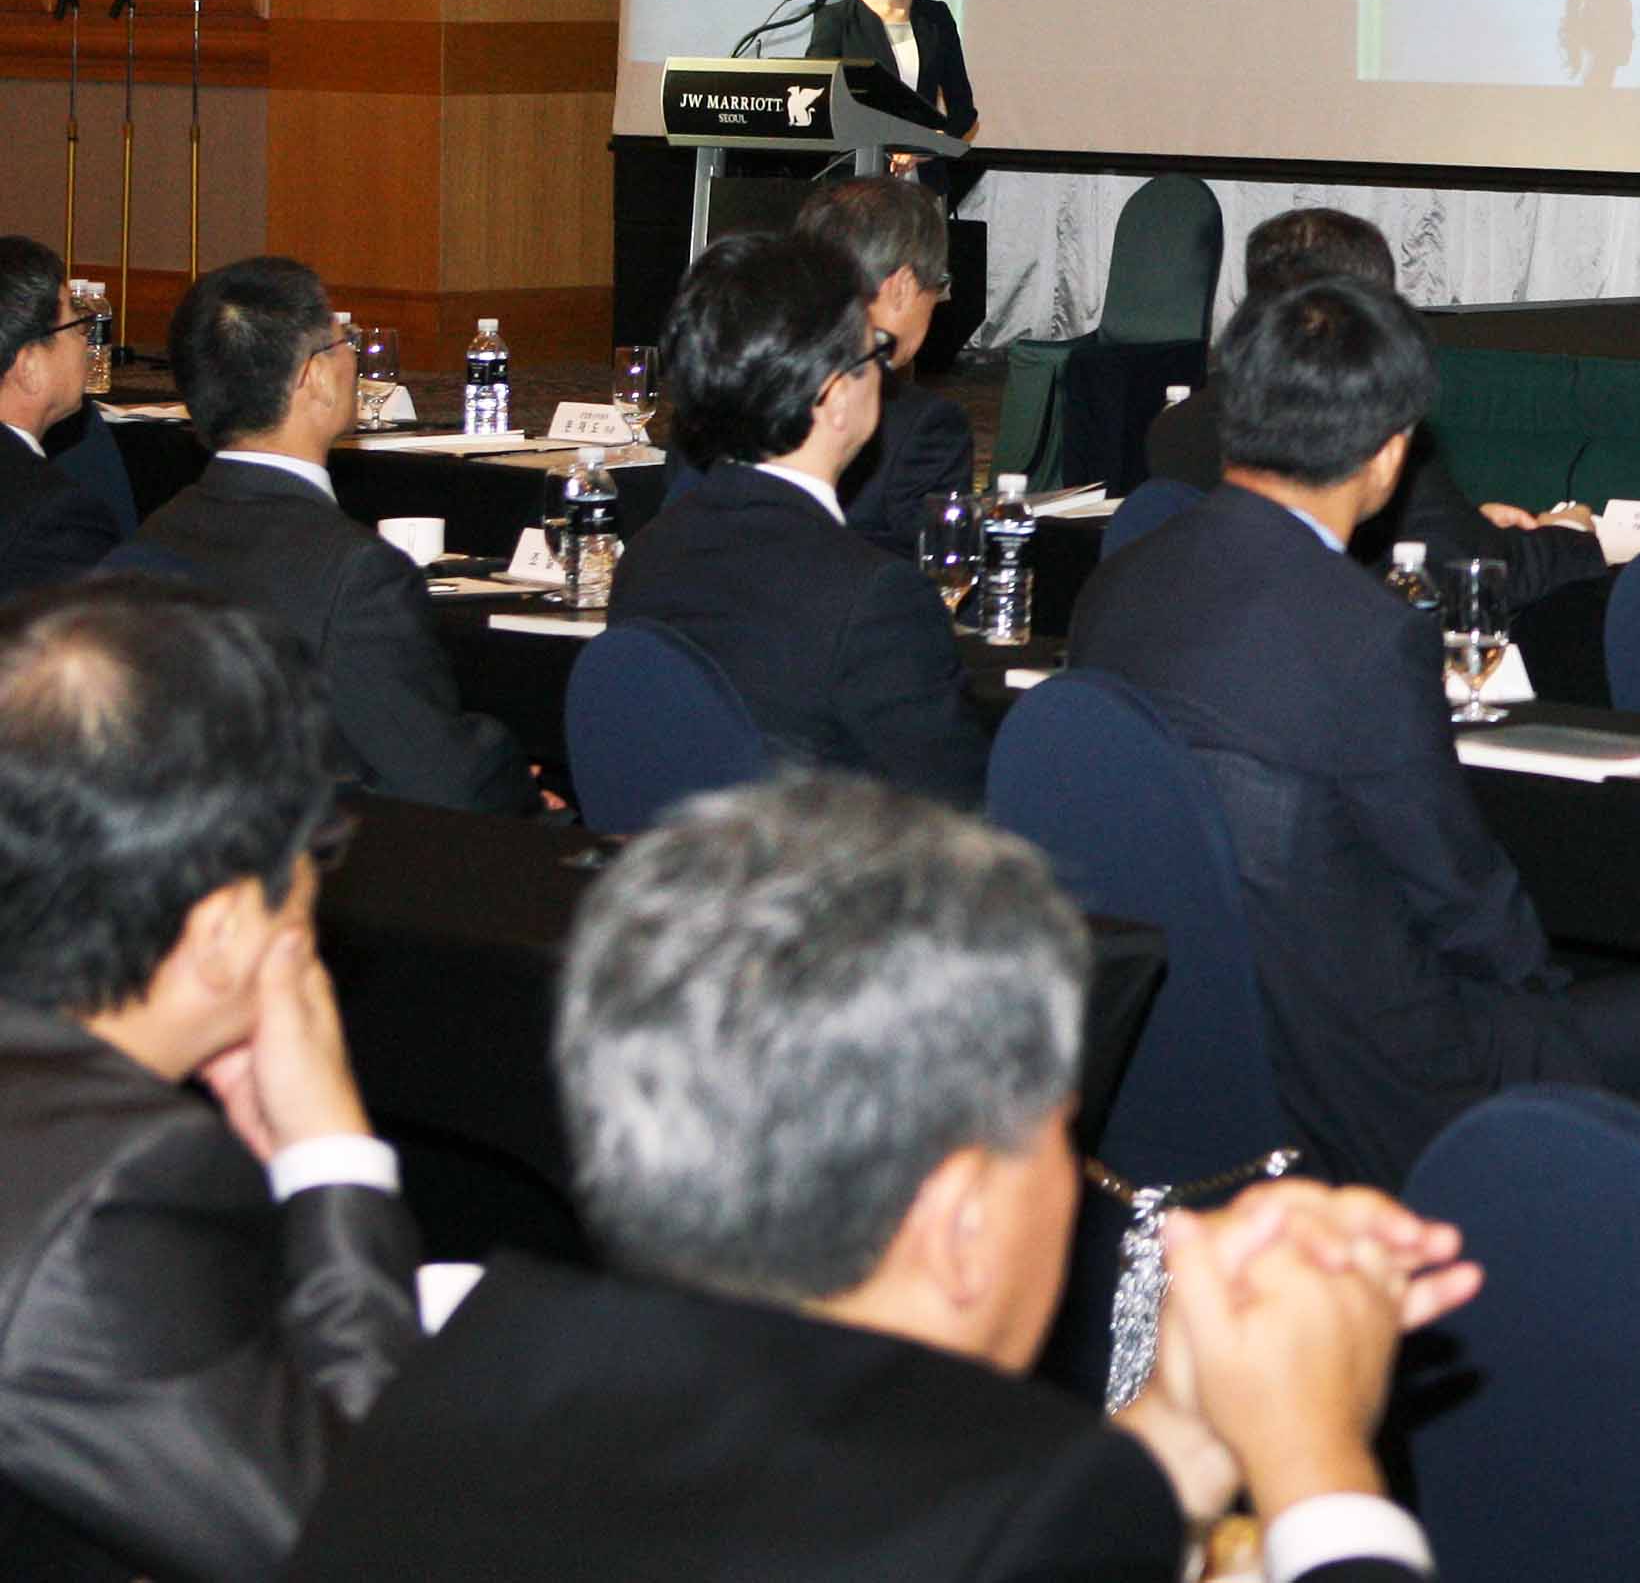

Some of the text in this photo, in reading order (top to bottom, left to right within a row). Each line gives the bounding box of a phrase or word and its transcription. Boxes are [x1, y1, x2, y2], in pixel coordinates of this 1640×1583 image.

[679, 92, 783, 112] JW MARRIOTT
[718, 113, 747, 124] SEOUL
